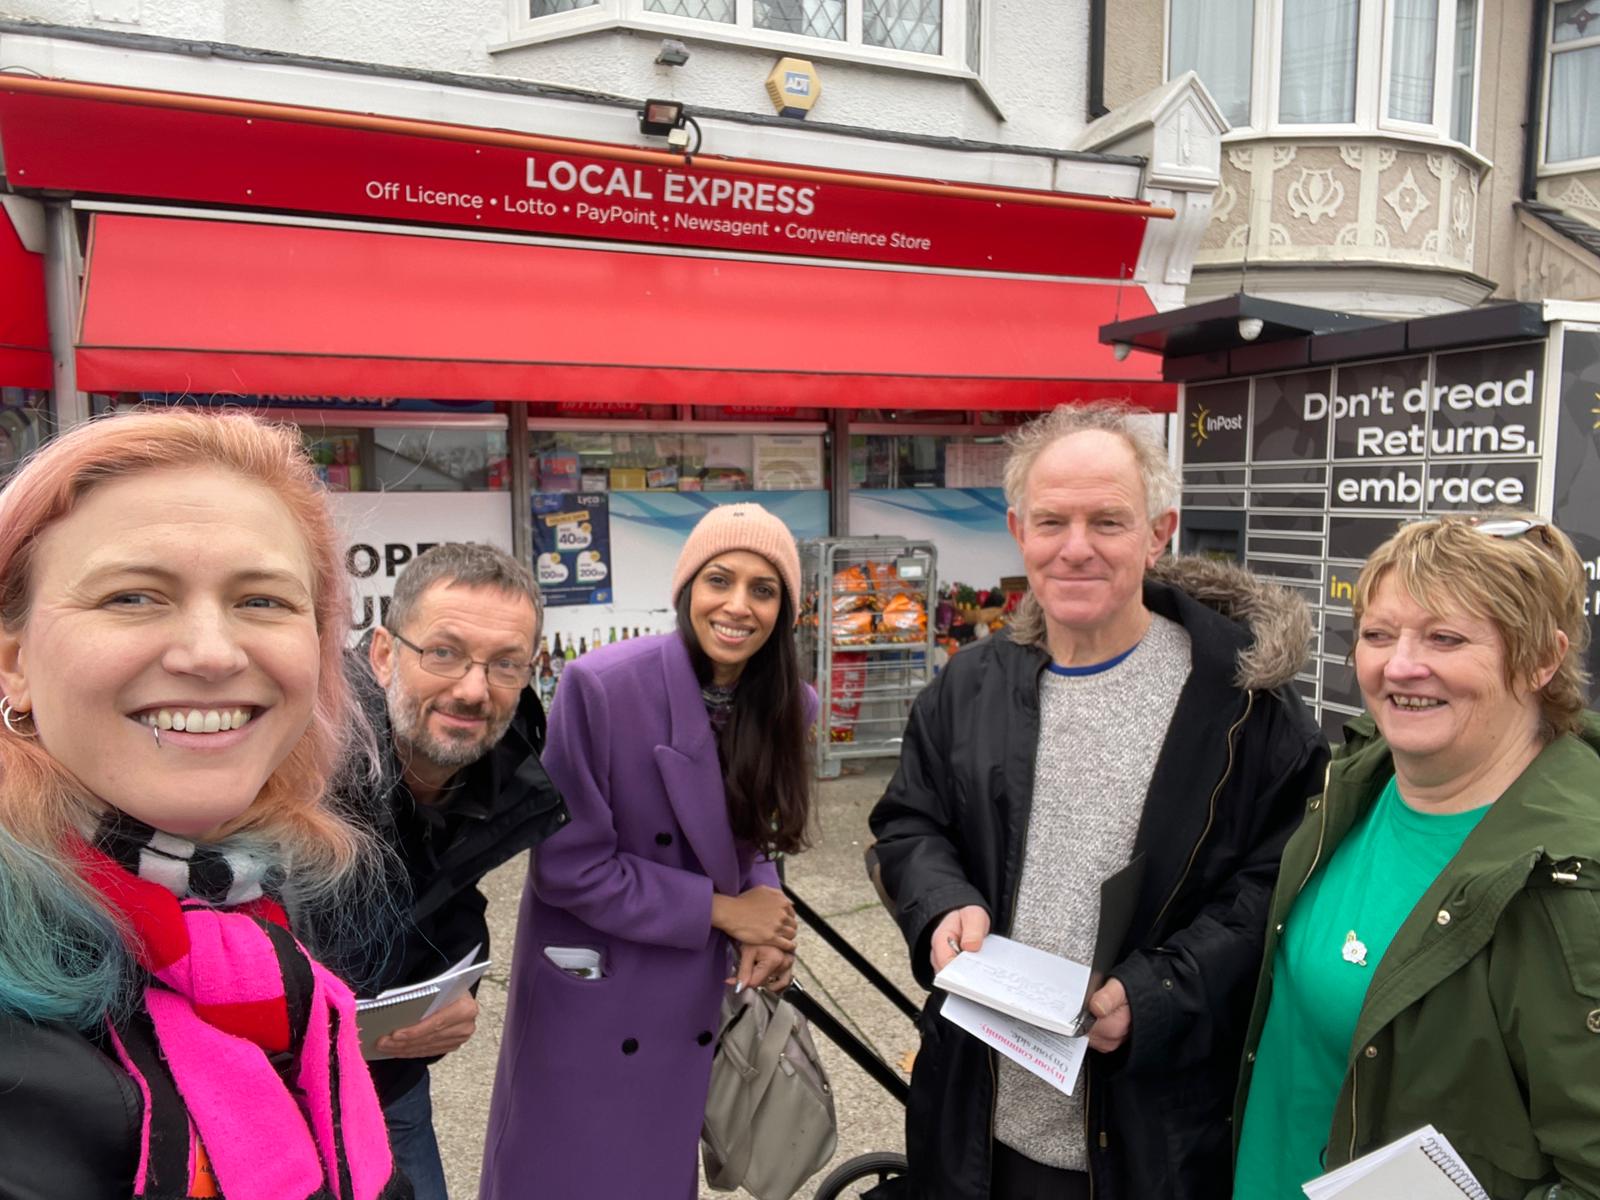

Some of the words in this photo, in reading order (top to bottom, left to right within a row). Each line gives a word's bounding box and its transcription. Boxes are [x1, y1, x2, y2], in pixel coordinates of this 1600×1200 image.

[526, 157, 653, 200] LOCAL
[664, 172, 815, 216] EXPRESS
[366, 181, 400, 201] Off
[405, 185, 484, 209] Licence
[504, 195, 557, 216] Lotto
[576, 202, 657, 225] PayPoint
[675, 212, 769, 237] Newsagent
[785, 223, 887, 246] Convenience
[890, 232, 931, 250] Store
[1303, 386, 1395, 421] Don't
[1403, 370, 1534, 413] dread
[1207, 414, 1242, 431] InPost
[1357, 424, 1535, 456] Returns,
[1337, 472, 1524, 504] embrace
[1033, 1045, 1053, 1061] your
[1034, 1058, 1055, 1075] your
[1054, 1058, 1068, 1073] On
